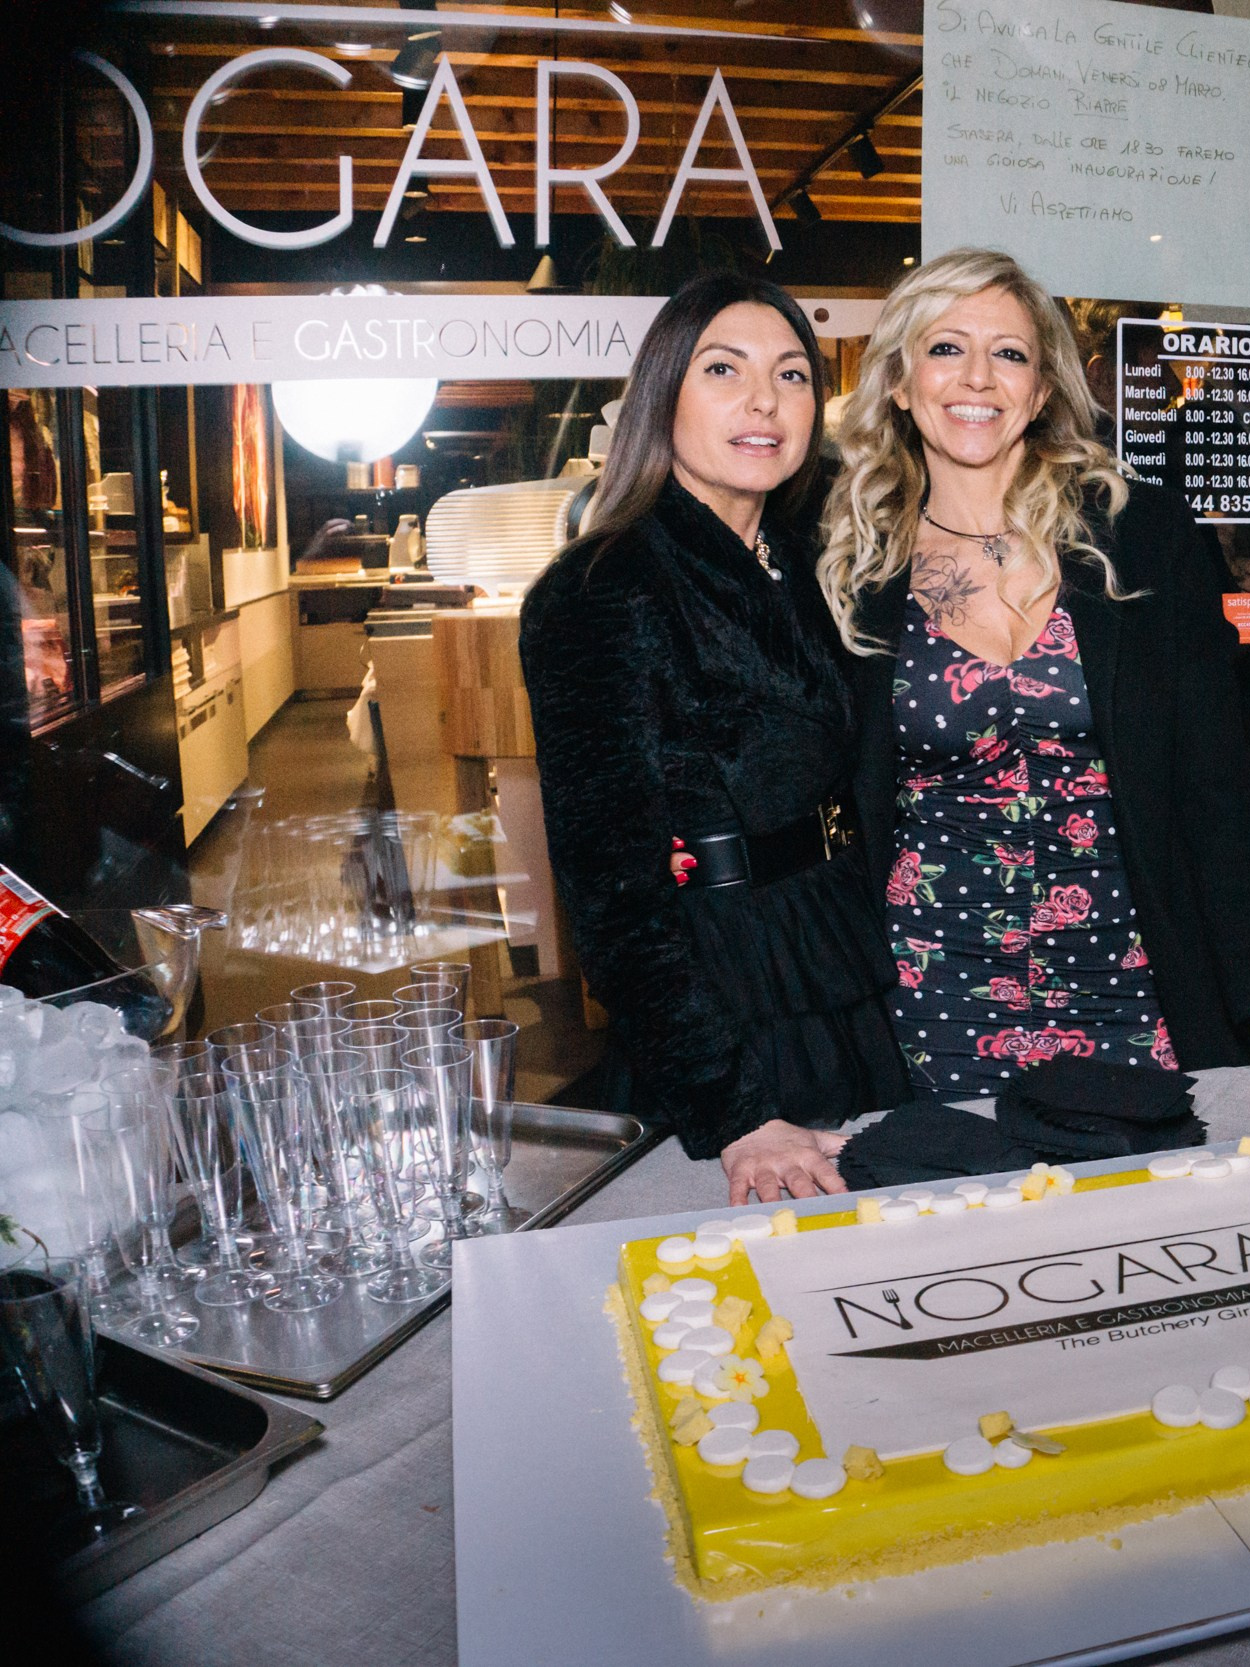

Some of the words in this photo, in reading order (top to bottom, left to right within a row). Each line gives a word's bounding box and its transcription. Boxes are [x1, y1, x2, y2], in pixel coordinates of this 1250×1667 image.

[937, 0, 967, 33] Si
[1054, 17, 1077, 44] LA
[941, 51, 973, 69] CHE
[1148, 78, 1168, 92] 08
[1079, 136, 1108, 151] ORE
[1176, 144, 1236, 161] FAREMO
[943, 153, 969, 168] UNA
[251, 320, 273, 361] E
[293, 318, 633, 361] GASTRONOMIA
[1125, 362, 1162, 378] Lunedì
[1185, 365, 1205, 379] 8.00
[1125, 385, 1167, 400] Martedì
[1185, 387, 1205, 401] 8.00
[1125, 407, 1178, 422] Mercoledì
[1185, 409, 1205, 423] 8.00
[1125, 429, 1166, 444] Giovedì
[1185, 431, 1205, 444] 8.00
[1125, 451, 1167, 466] Venerdì
[1185, 453, 1205, 467] 8.00
[1185, 475, 1205, 488] 8.00
[937, 1321, 1072, 1354] MACELLERIA
[1075, 1317, 1091, 1330] E
[1054, 1335, 1101, 1351] The
[1108, 1313, 1210, 1343] Butchery
